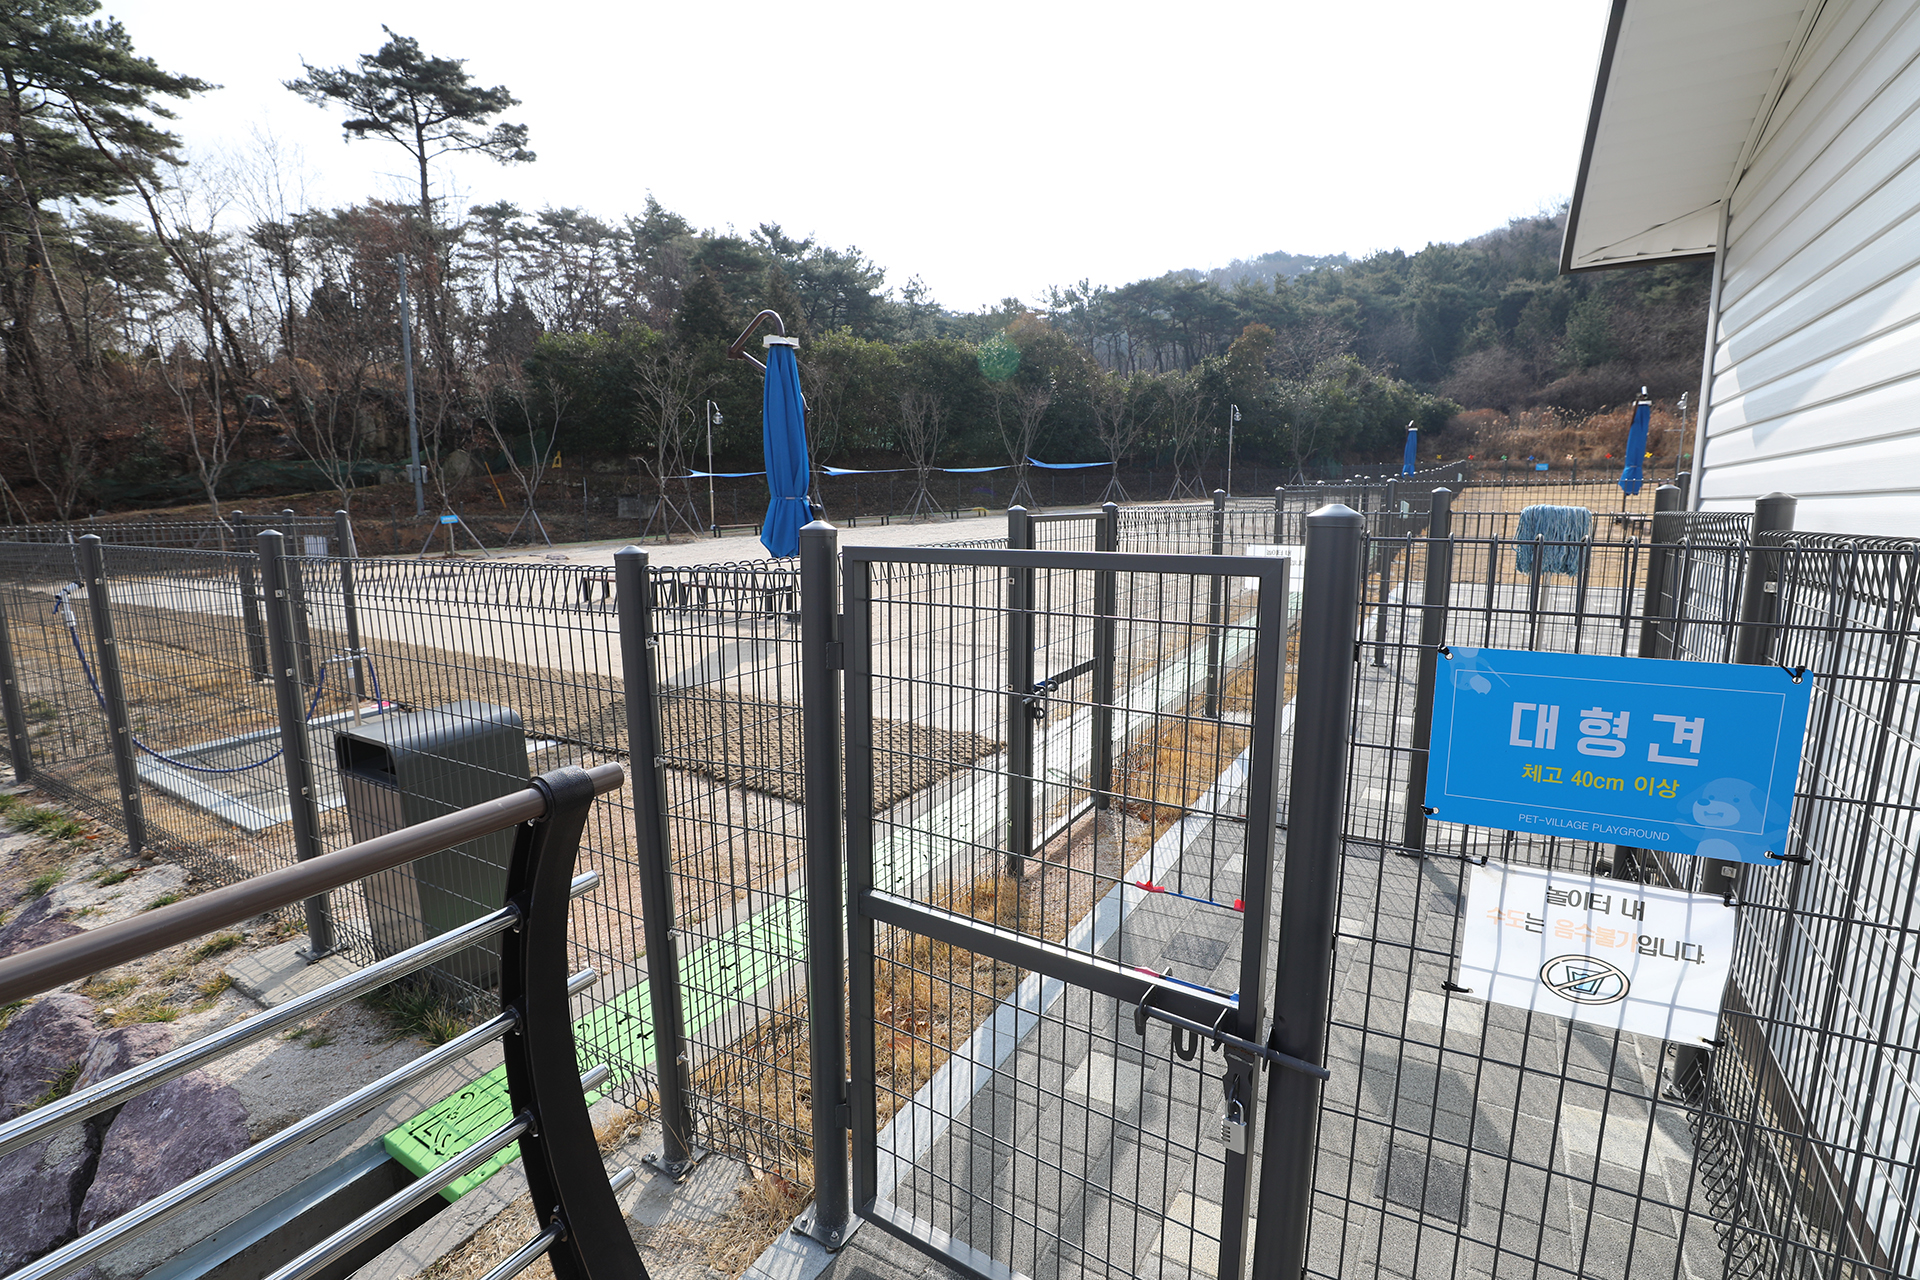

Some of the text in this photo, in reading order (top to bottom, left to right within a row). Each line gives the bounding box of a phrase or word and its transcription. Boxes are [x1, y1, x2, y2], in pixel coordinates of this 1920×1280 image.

[1521, 763, 1680, 799] 체고 40cm 이상
[1517, 812, 1670, 842] PET-VILLAGE PLAYGROUND
[1486, 906, 1545, 934] 수도는
[1546, 885, 1645, 922] 놀이터 내
